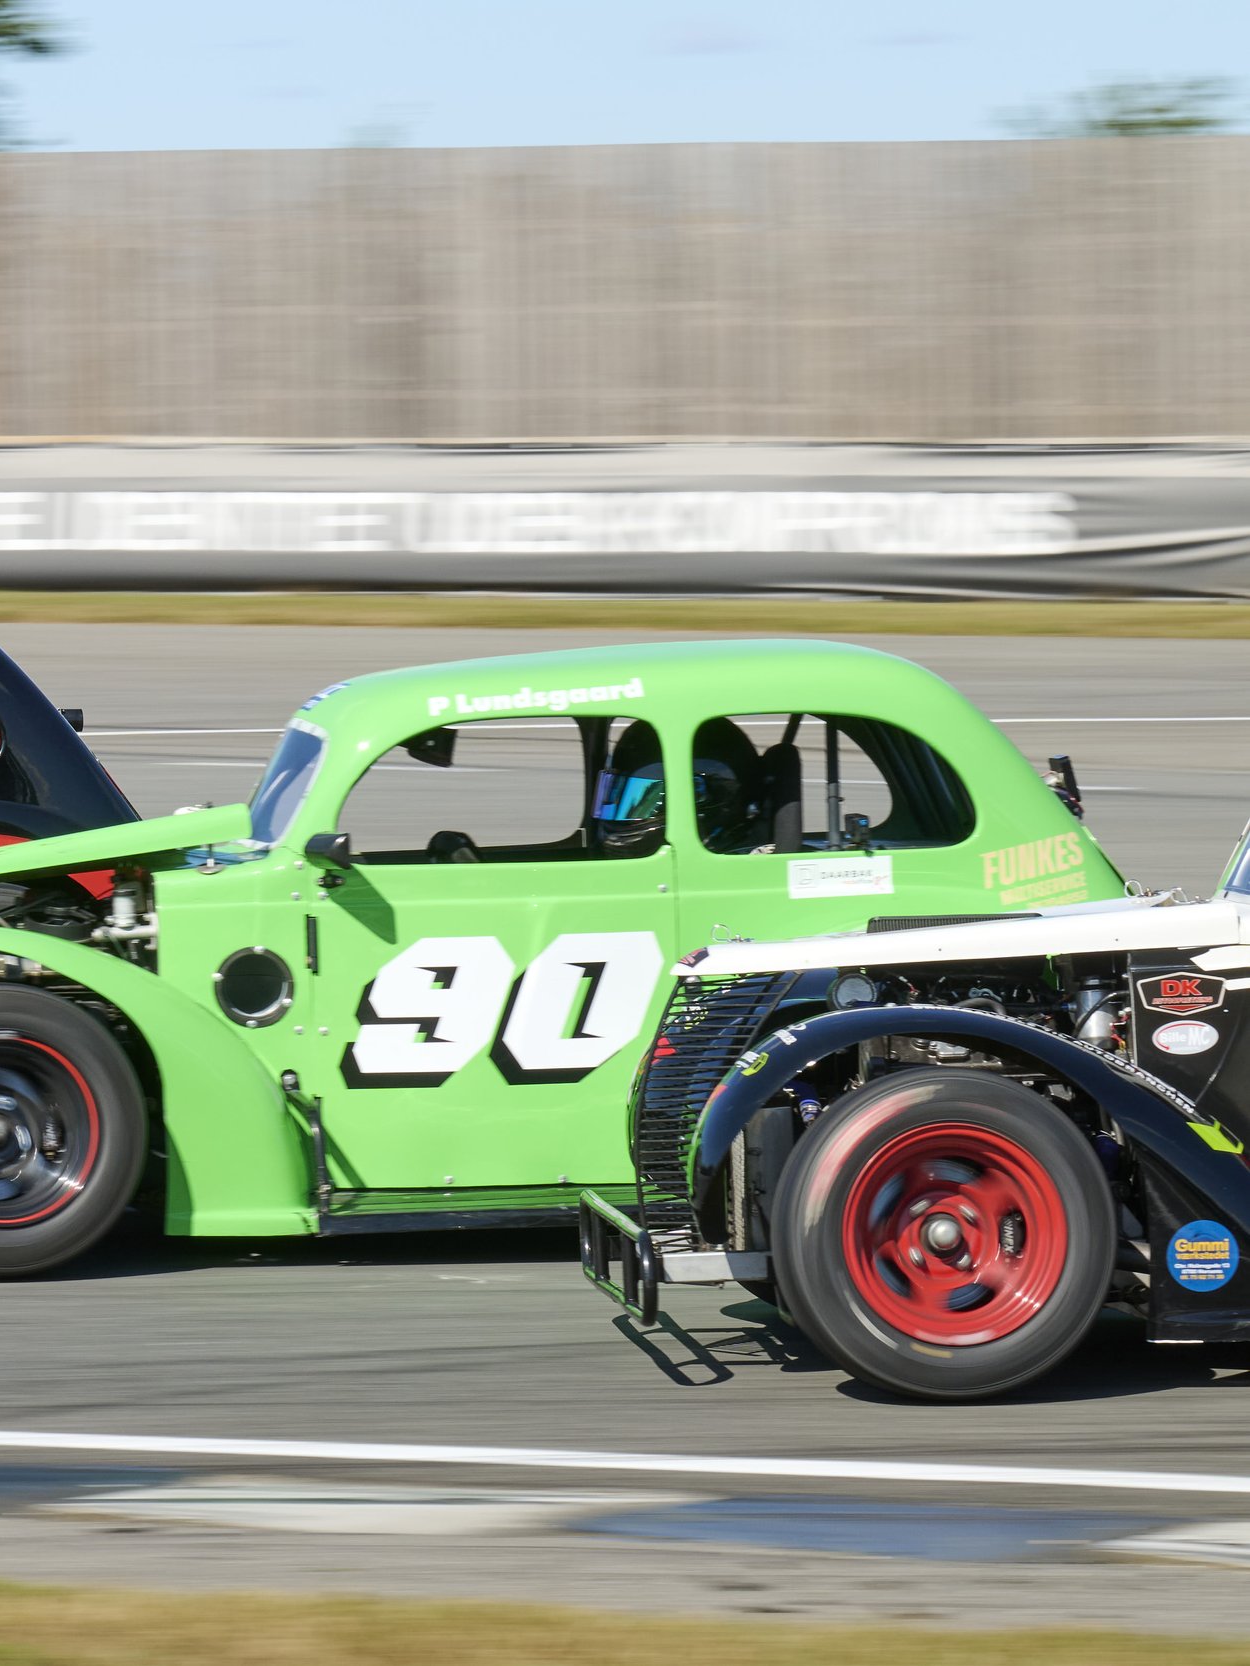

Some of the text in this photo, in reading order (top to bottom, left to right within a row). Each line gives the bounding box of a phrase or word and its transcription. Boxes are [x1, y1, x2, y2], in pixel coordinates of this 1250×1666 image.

[427, 677, 645, 716] P Lundsgaard
[980, 832, 1084, 889] FUNKES
[1160, 979, 1203, 997] DK
[342, 931, 664, 1088] 90
[1188, 1027, 1211, 1046] MC
[1174, 1238, 1229, 1252] Gummi
